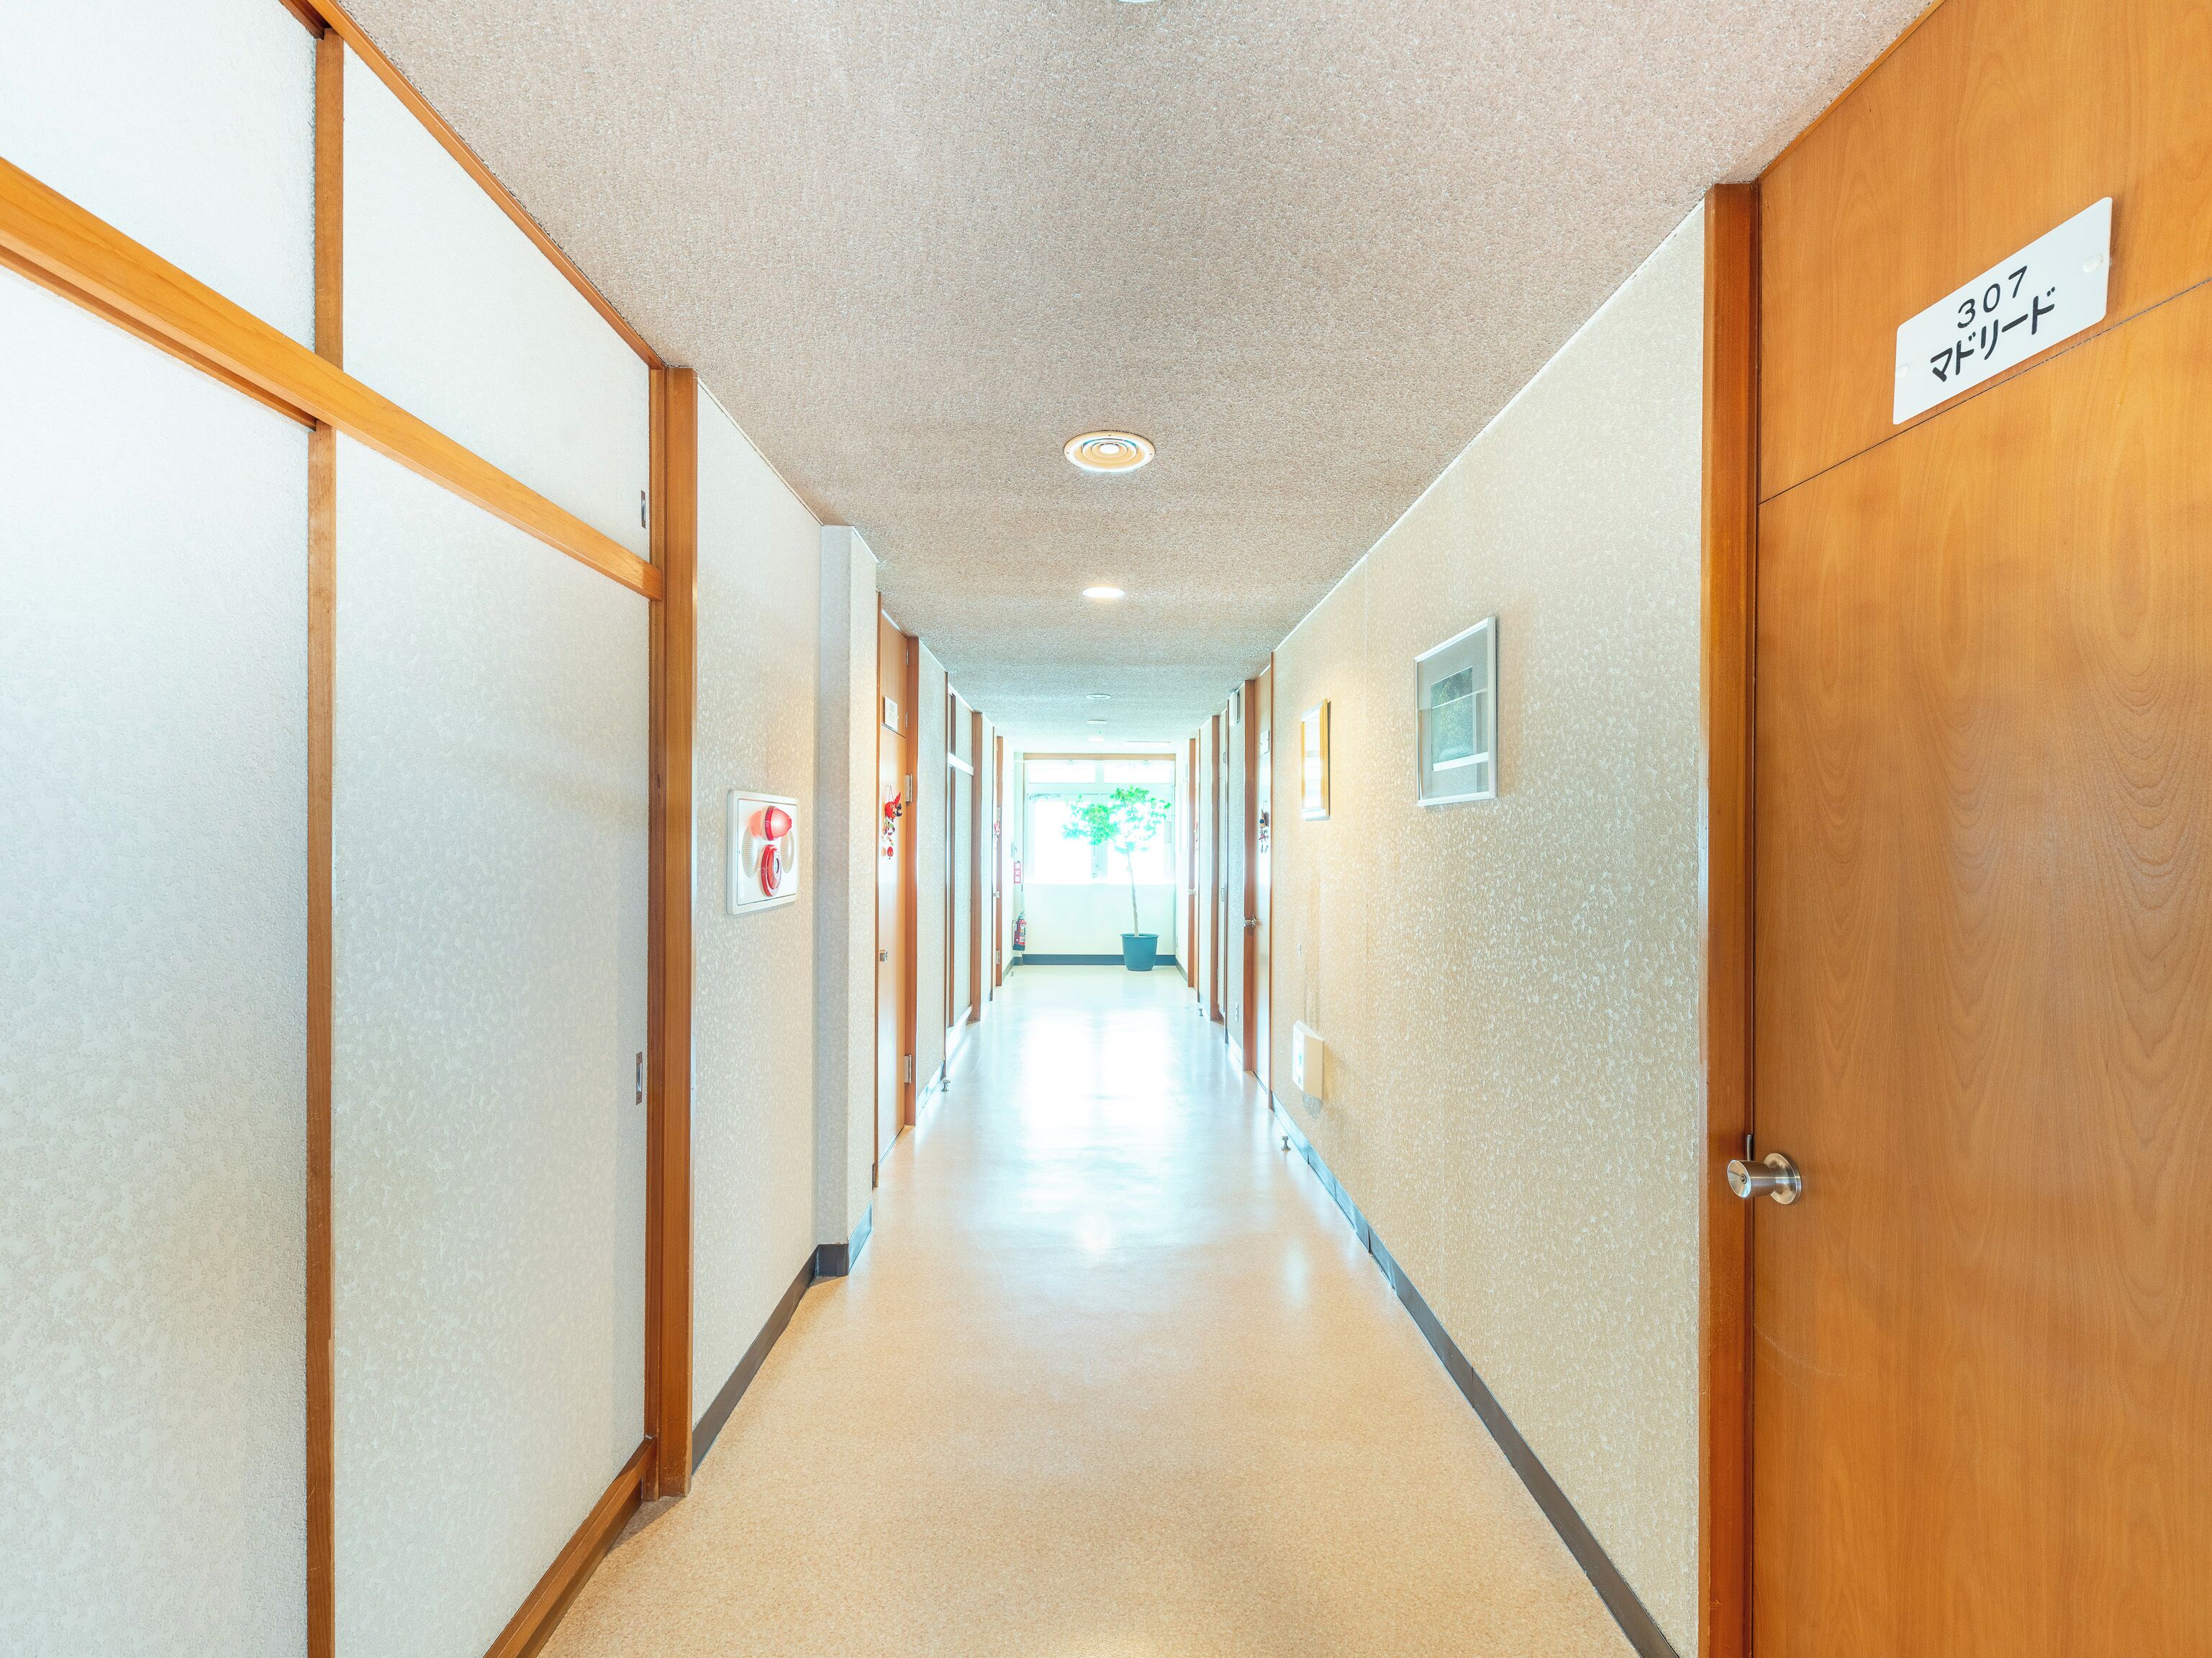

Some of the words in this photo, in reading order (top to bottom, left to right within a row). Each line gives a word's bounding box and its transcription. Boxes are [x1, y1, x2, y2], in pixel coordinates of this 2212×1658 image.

[1931, 286, 2055, 381] マドリード
[1957, 266, 2028, 329] 307
